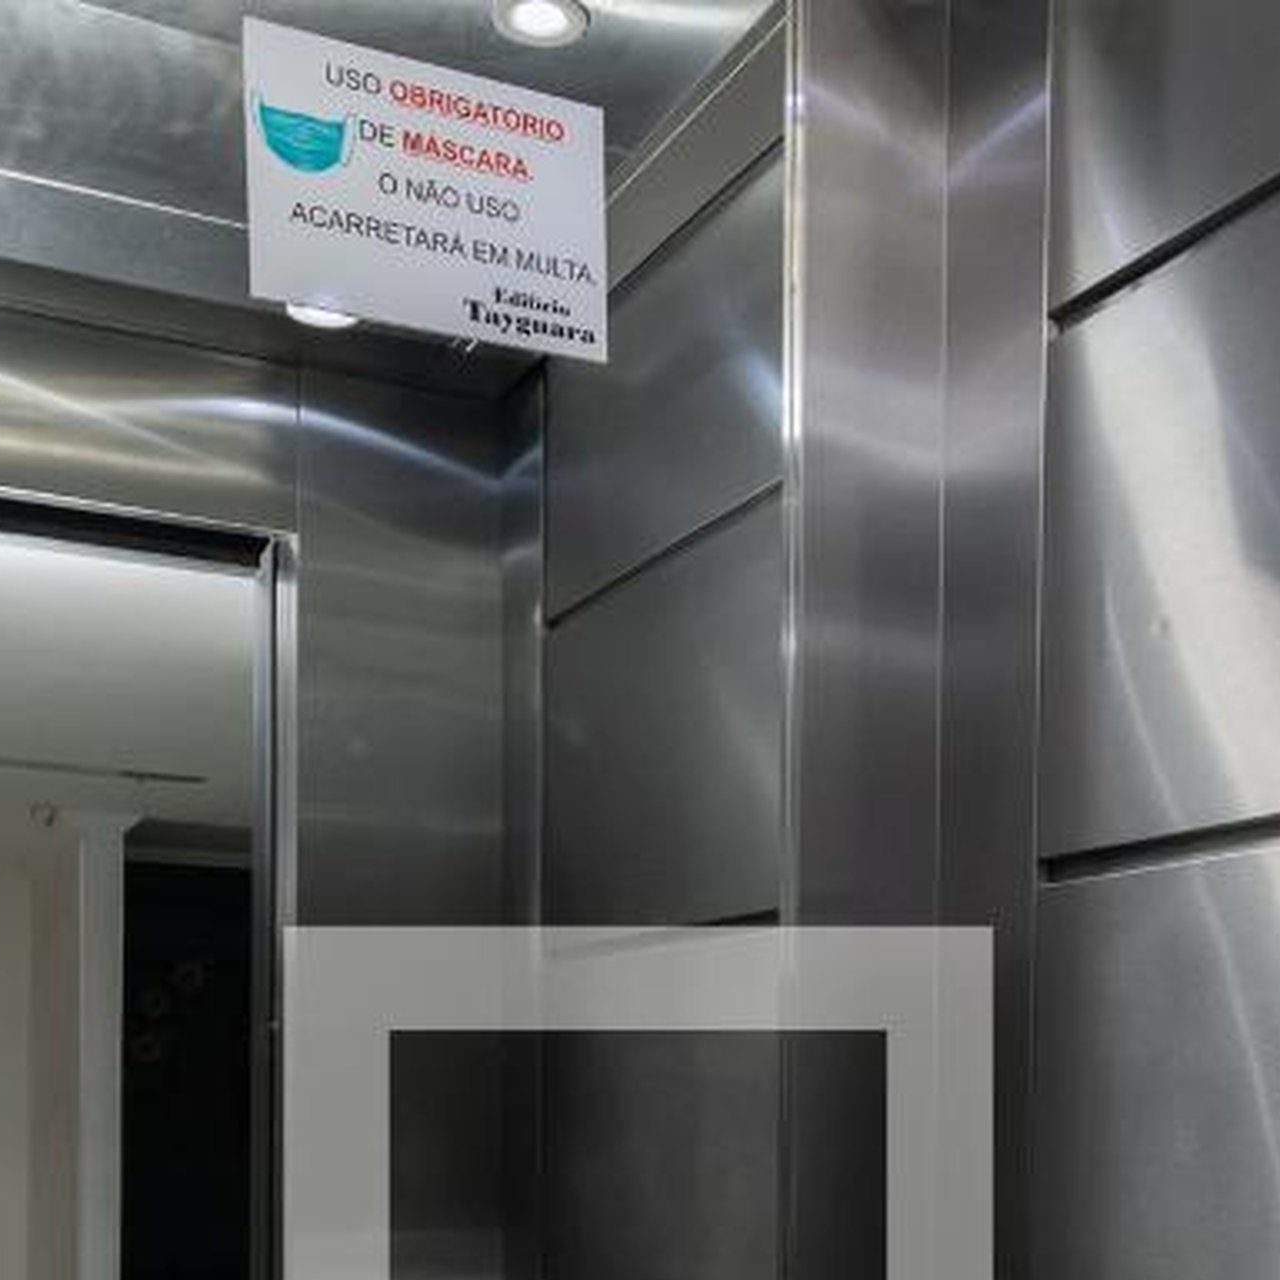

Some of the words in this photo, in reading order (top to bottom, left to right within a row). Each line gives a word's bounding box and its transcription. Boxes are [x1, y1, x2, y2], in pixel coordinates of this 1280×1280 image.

[324, 61, 382, 96] USO
[359, 118, 395, 149] DE
[379, 172, 399, 195] O
[406, 177, 460, 210] NÃO
[467, 192, 521, 223] USO
[472, 242, 509, 269] EM
[464, 299, 596, 344] Tayguara
